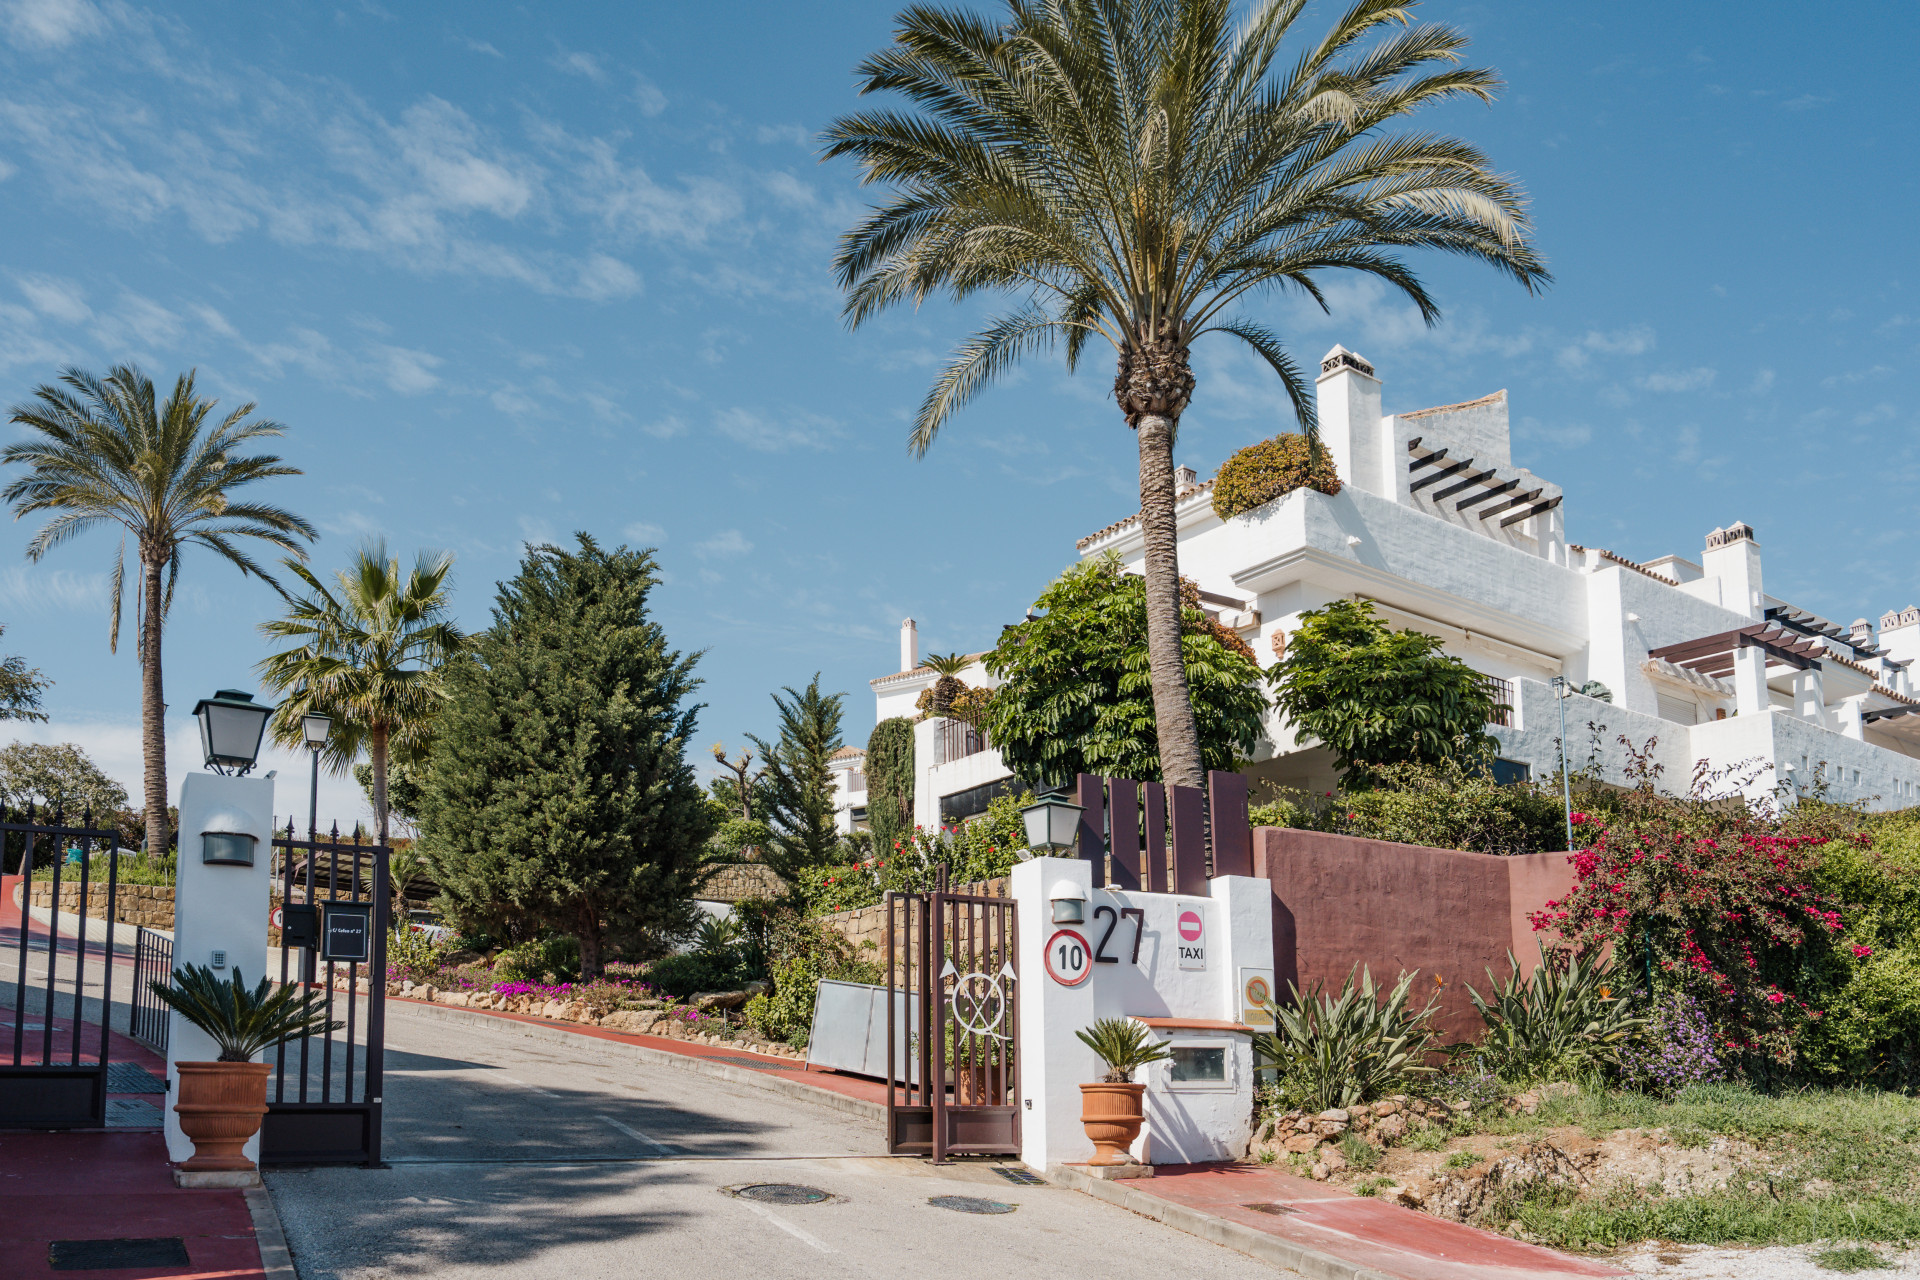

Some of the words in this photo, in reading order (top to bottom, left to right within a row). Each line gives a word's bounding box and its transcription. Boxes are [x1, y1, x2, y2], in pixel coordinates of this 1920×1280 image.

[1094, 905, 1145, 965] 27
[1058, 944, 1083, 971] 10
[1178, 946, 1204, 960] TAXI
